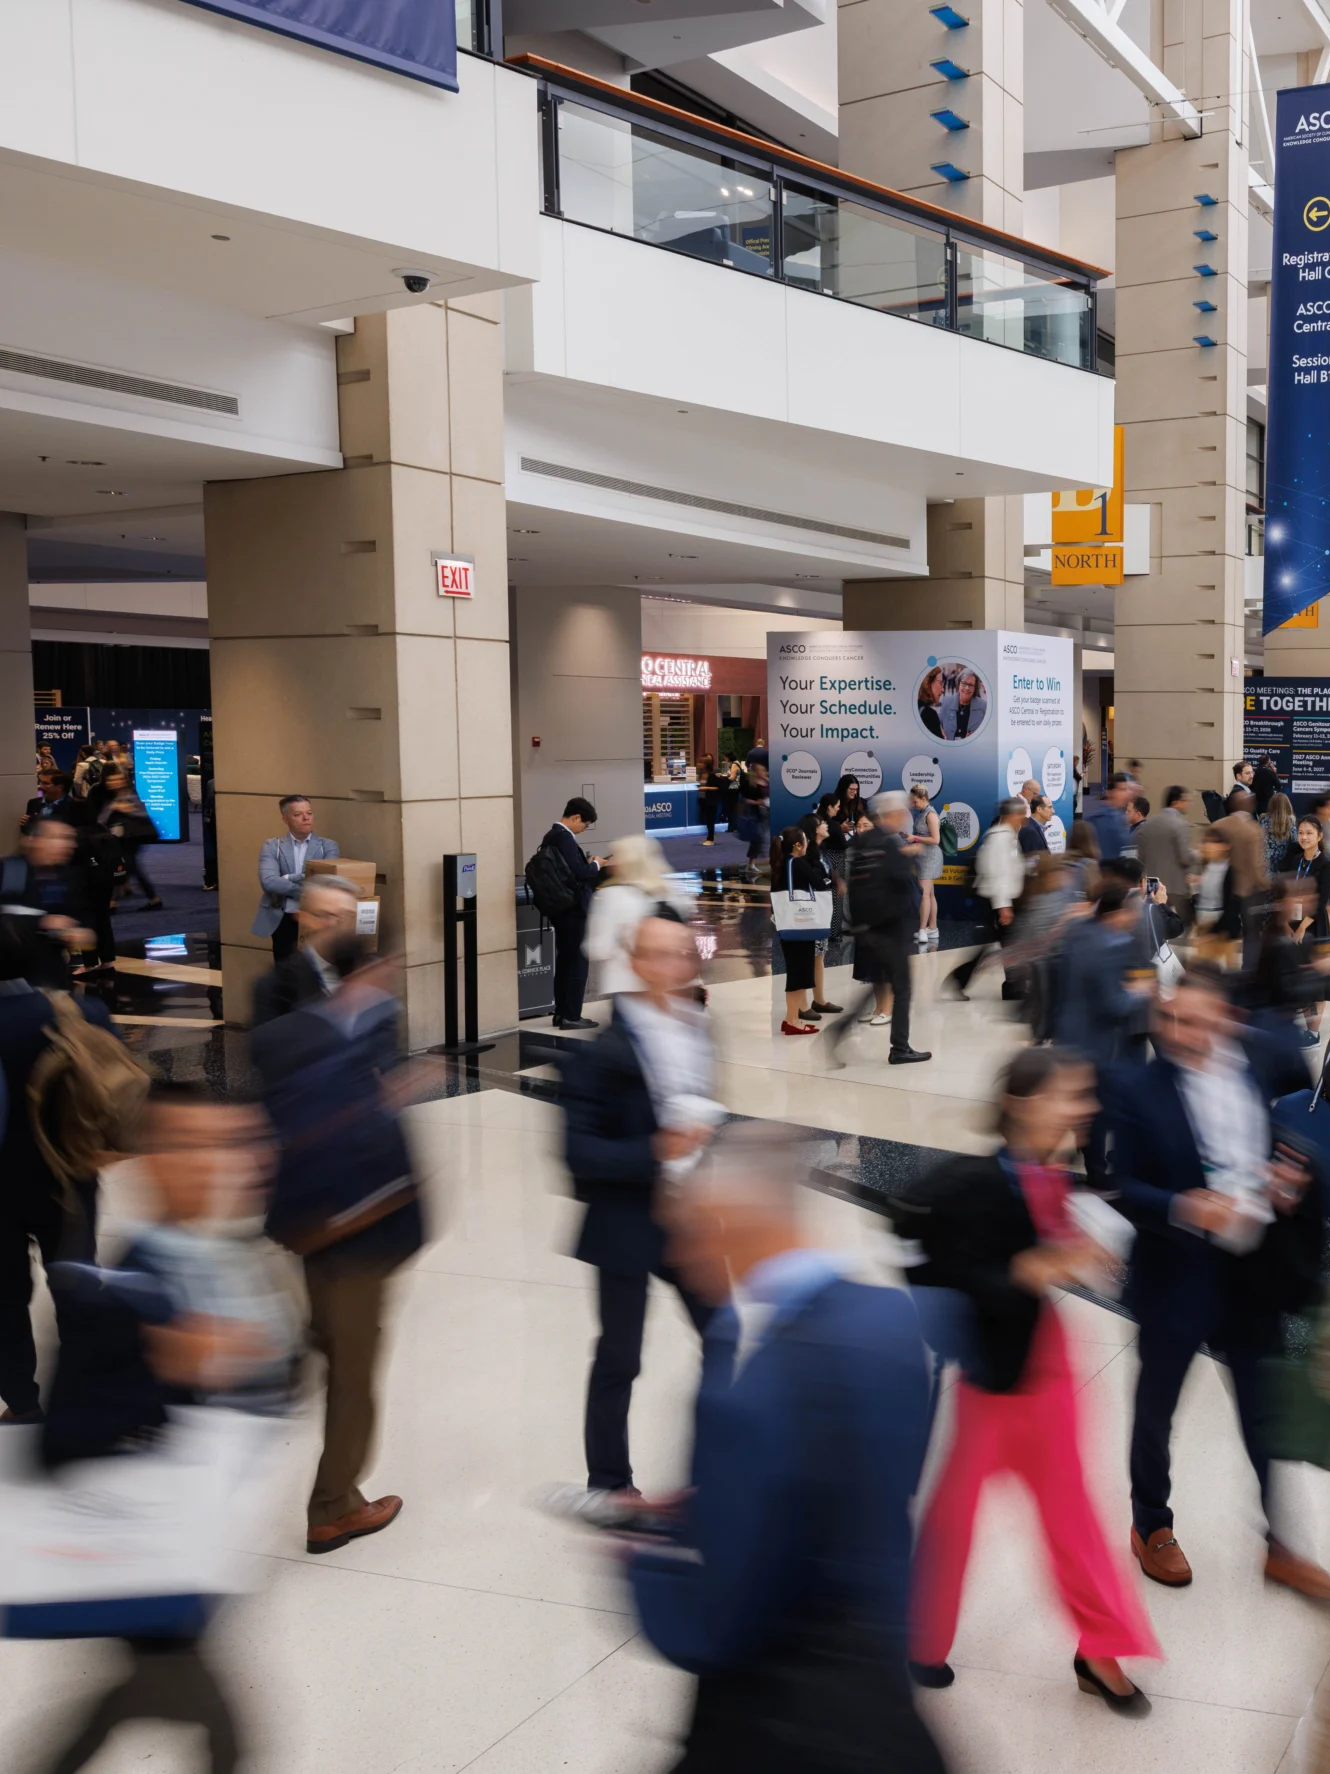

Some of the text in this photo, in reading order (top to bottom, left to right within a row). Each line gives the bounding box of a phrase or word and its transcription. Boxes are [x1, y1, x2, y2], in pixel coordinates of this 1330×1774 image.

[1299, 266, 1321, 281] Hall
[1294, 370, 1316, 384] Hall
[1054, 554, 1117, 568] NORTH
[441, 565, 469, 590] EXIT
[780, 644, 806, 654] ASCO
[1004, 645, 1017, 654] ASCO
[655, 657, 712, 676] CENTRAL
[664, 676, 711, 687] ASSISTANCE
[780, 676, 896, 694] Your Expertise.
[1013, 675, 1060, 691] Enter to Win
[780, 700, 896, 715] Your Schedule.
[780, 723, 879, 742] Your Impact.
[652, 802, 672, 812] ASCO
